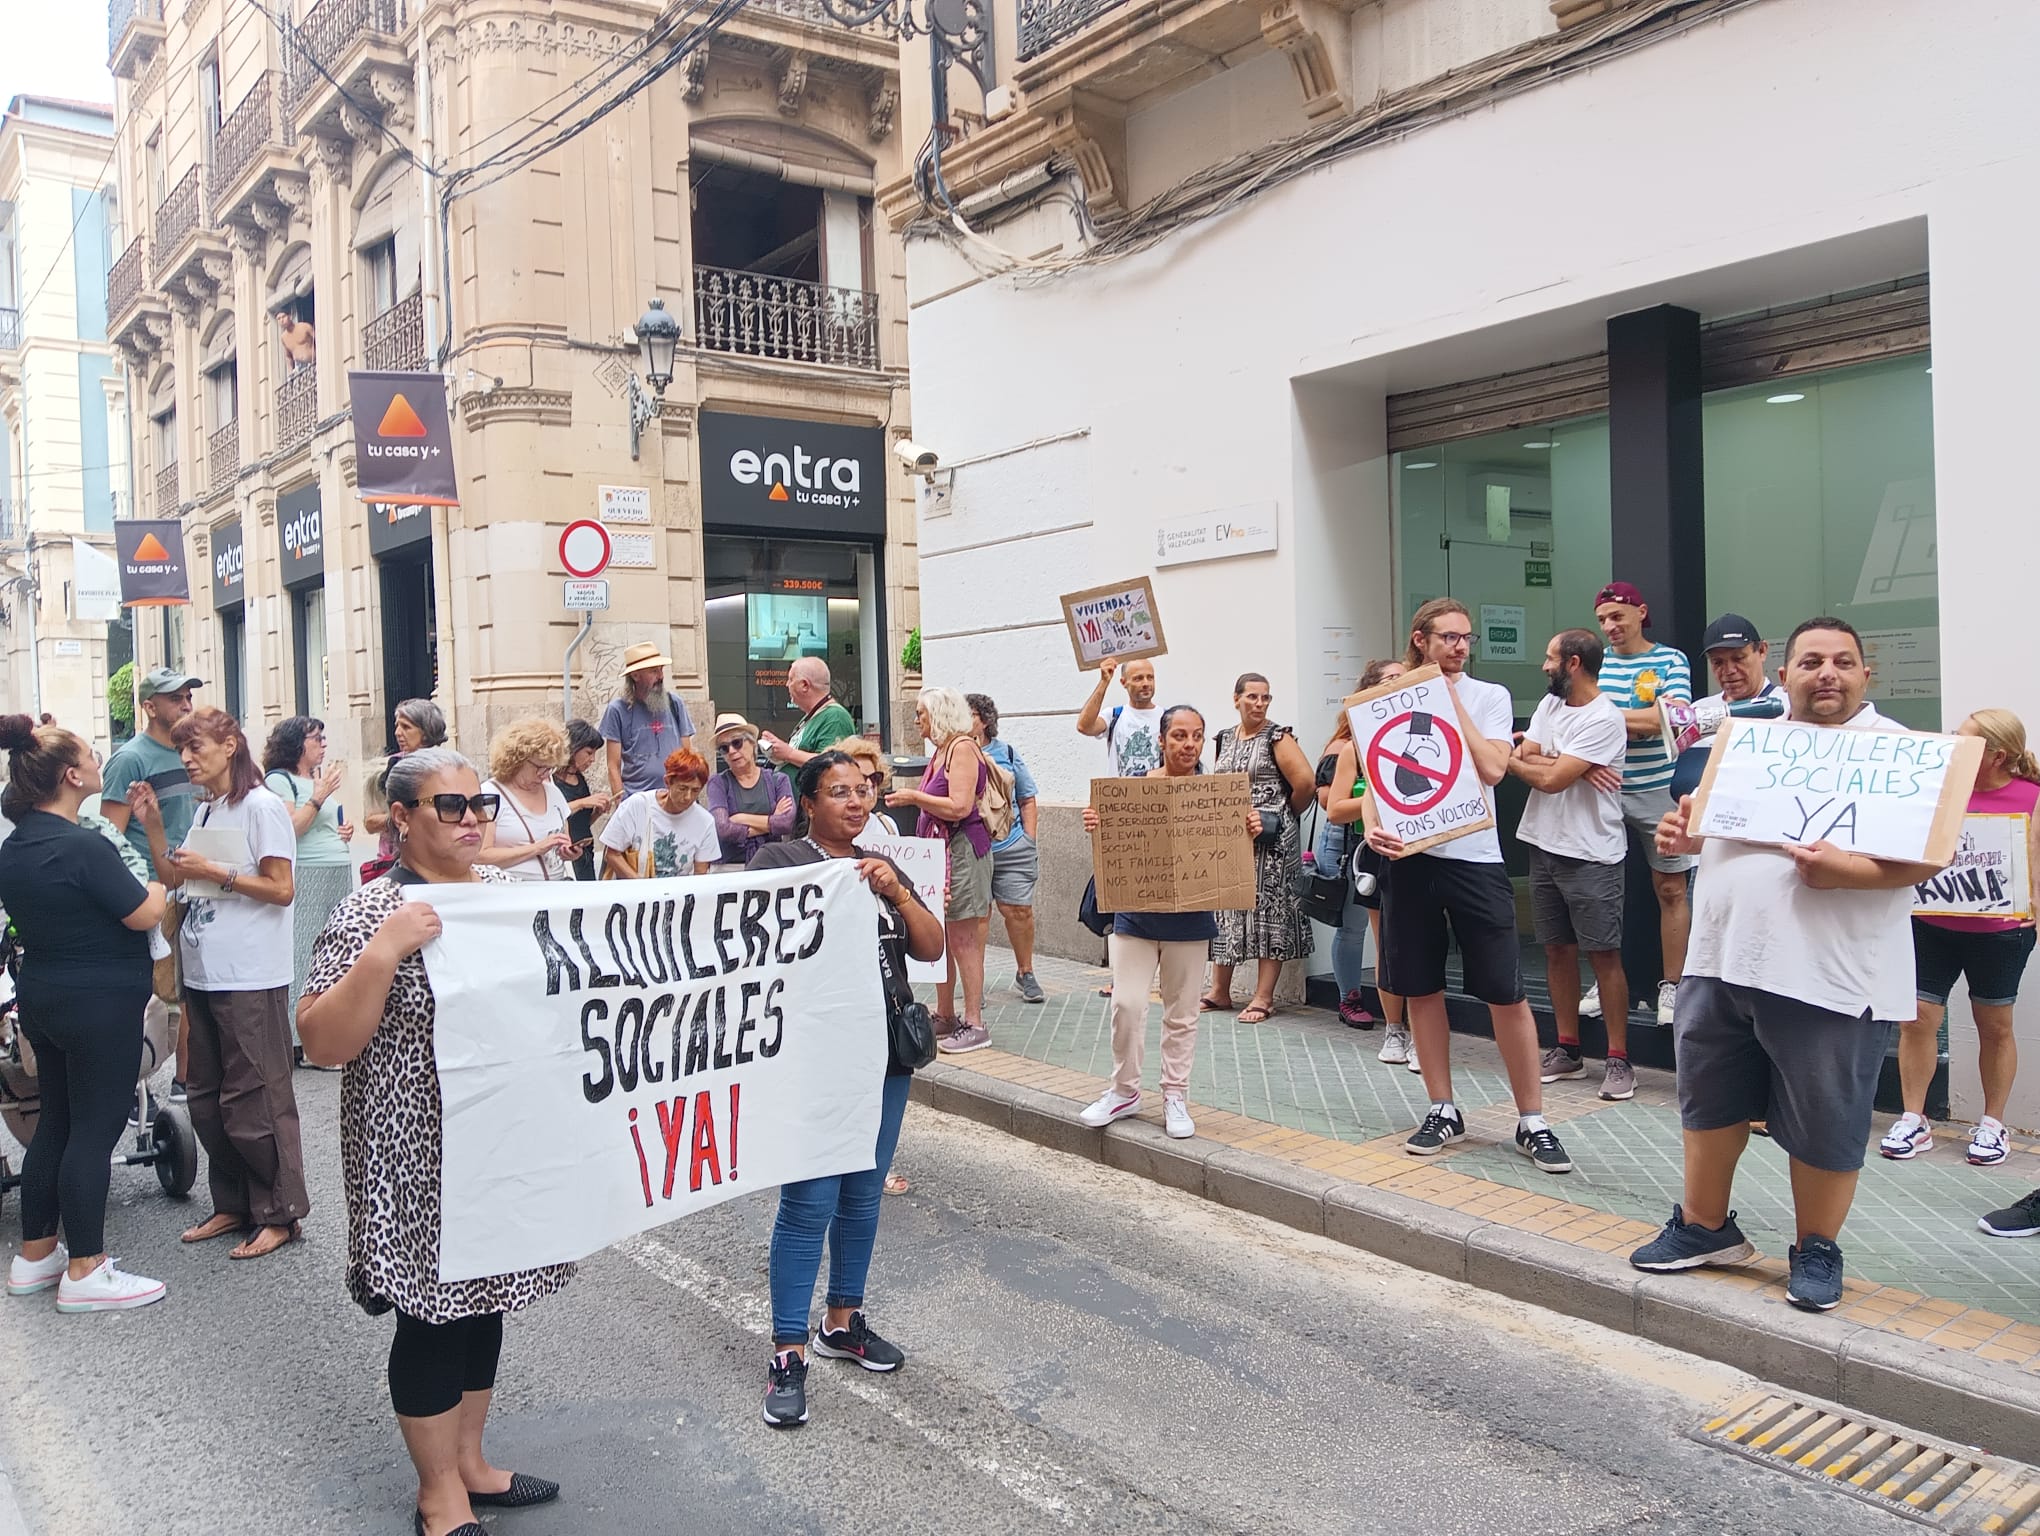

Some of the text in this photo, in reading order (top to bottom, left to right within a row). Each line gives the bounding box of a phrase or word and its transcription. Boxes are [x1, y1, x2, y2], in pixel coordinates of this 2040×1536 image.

[368, 443, 382, 457] tu
[385, 446, 418, 457] casa
[420, 446, 429, 460] y
[730, 445, 860, 493] entra
[796, 489, 809, 503] tu
[811, 493, 841, 505] casa
[843, 496, 851, 509] y
[284, 510, 320, 550] entra
[216, 543, 243, 579] entra
[1075, 594, 1132, 617] VIVIENDAS
[1371, 686, 1430, 720] STOP
[1732, 727, 1958, 771] ALQUILERES
[1142, 783, 1159, 796] UN
[1164, 781, 1220, 795] INFORME
[1230, 780, 1246, 792] DE
[1755, 762, 1926, 799] SOCIALES
[1099, 802, 1169, 815] EMERGENCIA
[1101, 818, 1113, 828] DE
[1173, 812, 1224, 825] SOCIALES
[1231, 810, 1240, 819] A
[1395, 797, 1487, 838] FONS VOLTORS
[1782, 795, 1858, 845] YA
[1101, 831, 1112, 842] EL
[1153, 828, 1159, 838] Y
[922, 848, 932, 860] A
[1107, 850, 1228, 869] MI FAMILIA Y YO
[1106, 875, 1128, 888] NOS
[1134, 872, 1176, 886] VAMOS
[1194, 869, 1208, 880] LA
[1137, 888, 1179, 900] CALLE
[532, 883, 825, 997] ALQUILERES
[580, 978, 785, 1104] SOCIALES
[628, 1083, 740, 1208] ¡YA!
